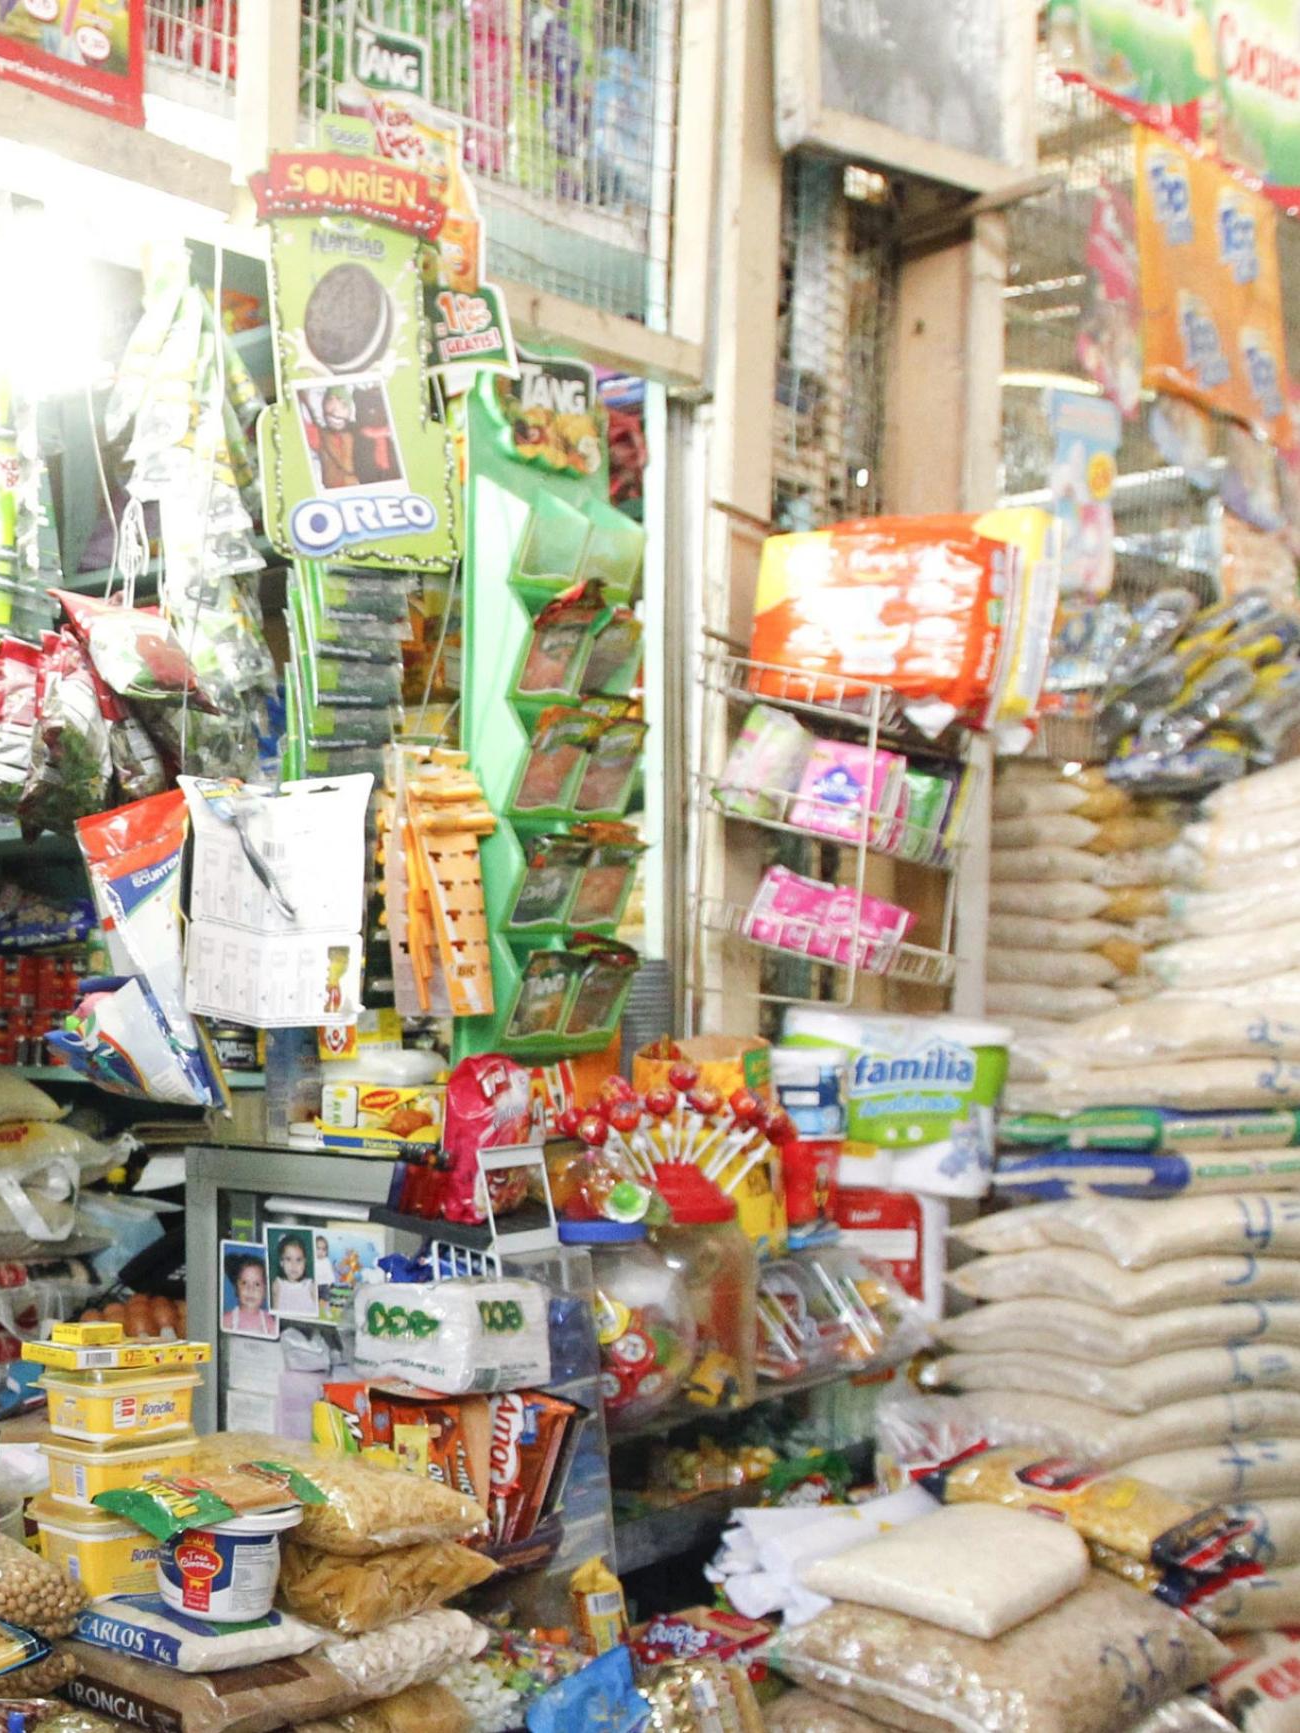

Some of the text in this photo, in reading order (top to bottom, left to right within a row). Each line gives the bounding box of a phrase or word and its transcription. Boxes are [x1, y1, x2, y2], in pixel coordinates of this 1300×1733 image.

[356, 28, 421, 89] TANG
[519, 362, 587, 416] TANG
[293, 496, 435, 549] OREO
[457, 966, 476, 977] BIC
[855, 1048, 974, 1087] familia
[491, 1394, 518, 1479] Amor
[79, 1615, 147, 1652] CARLOS
